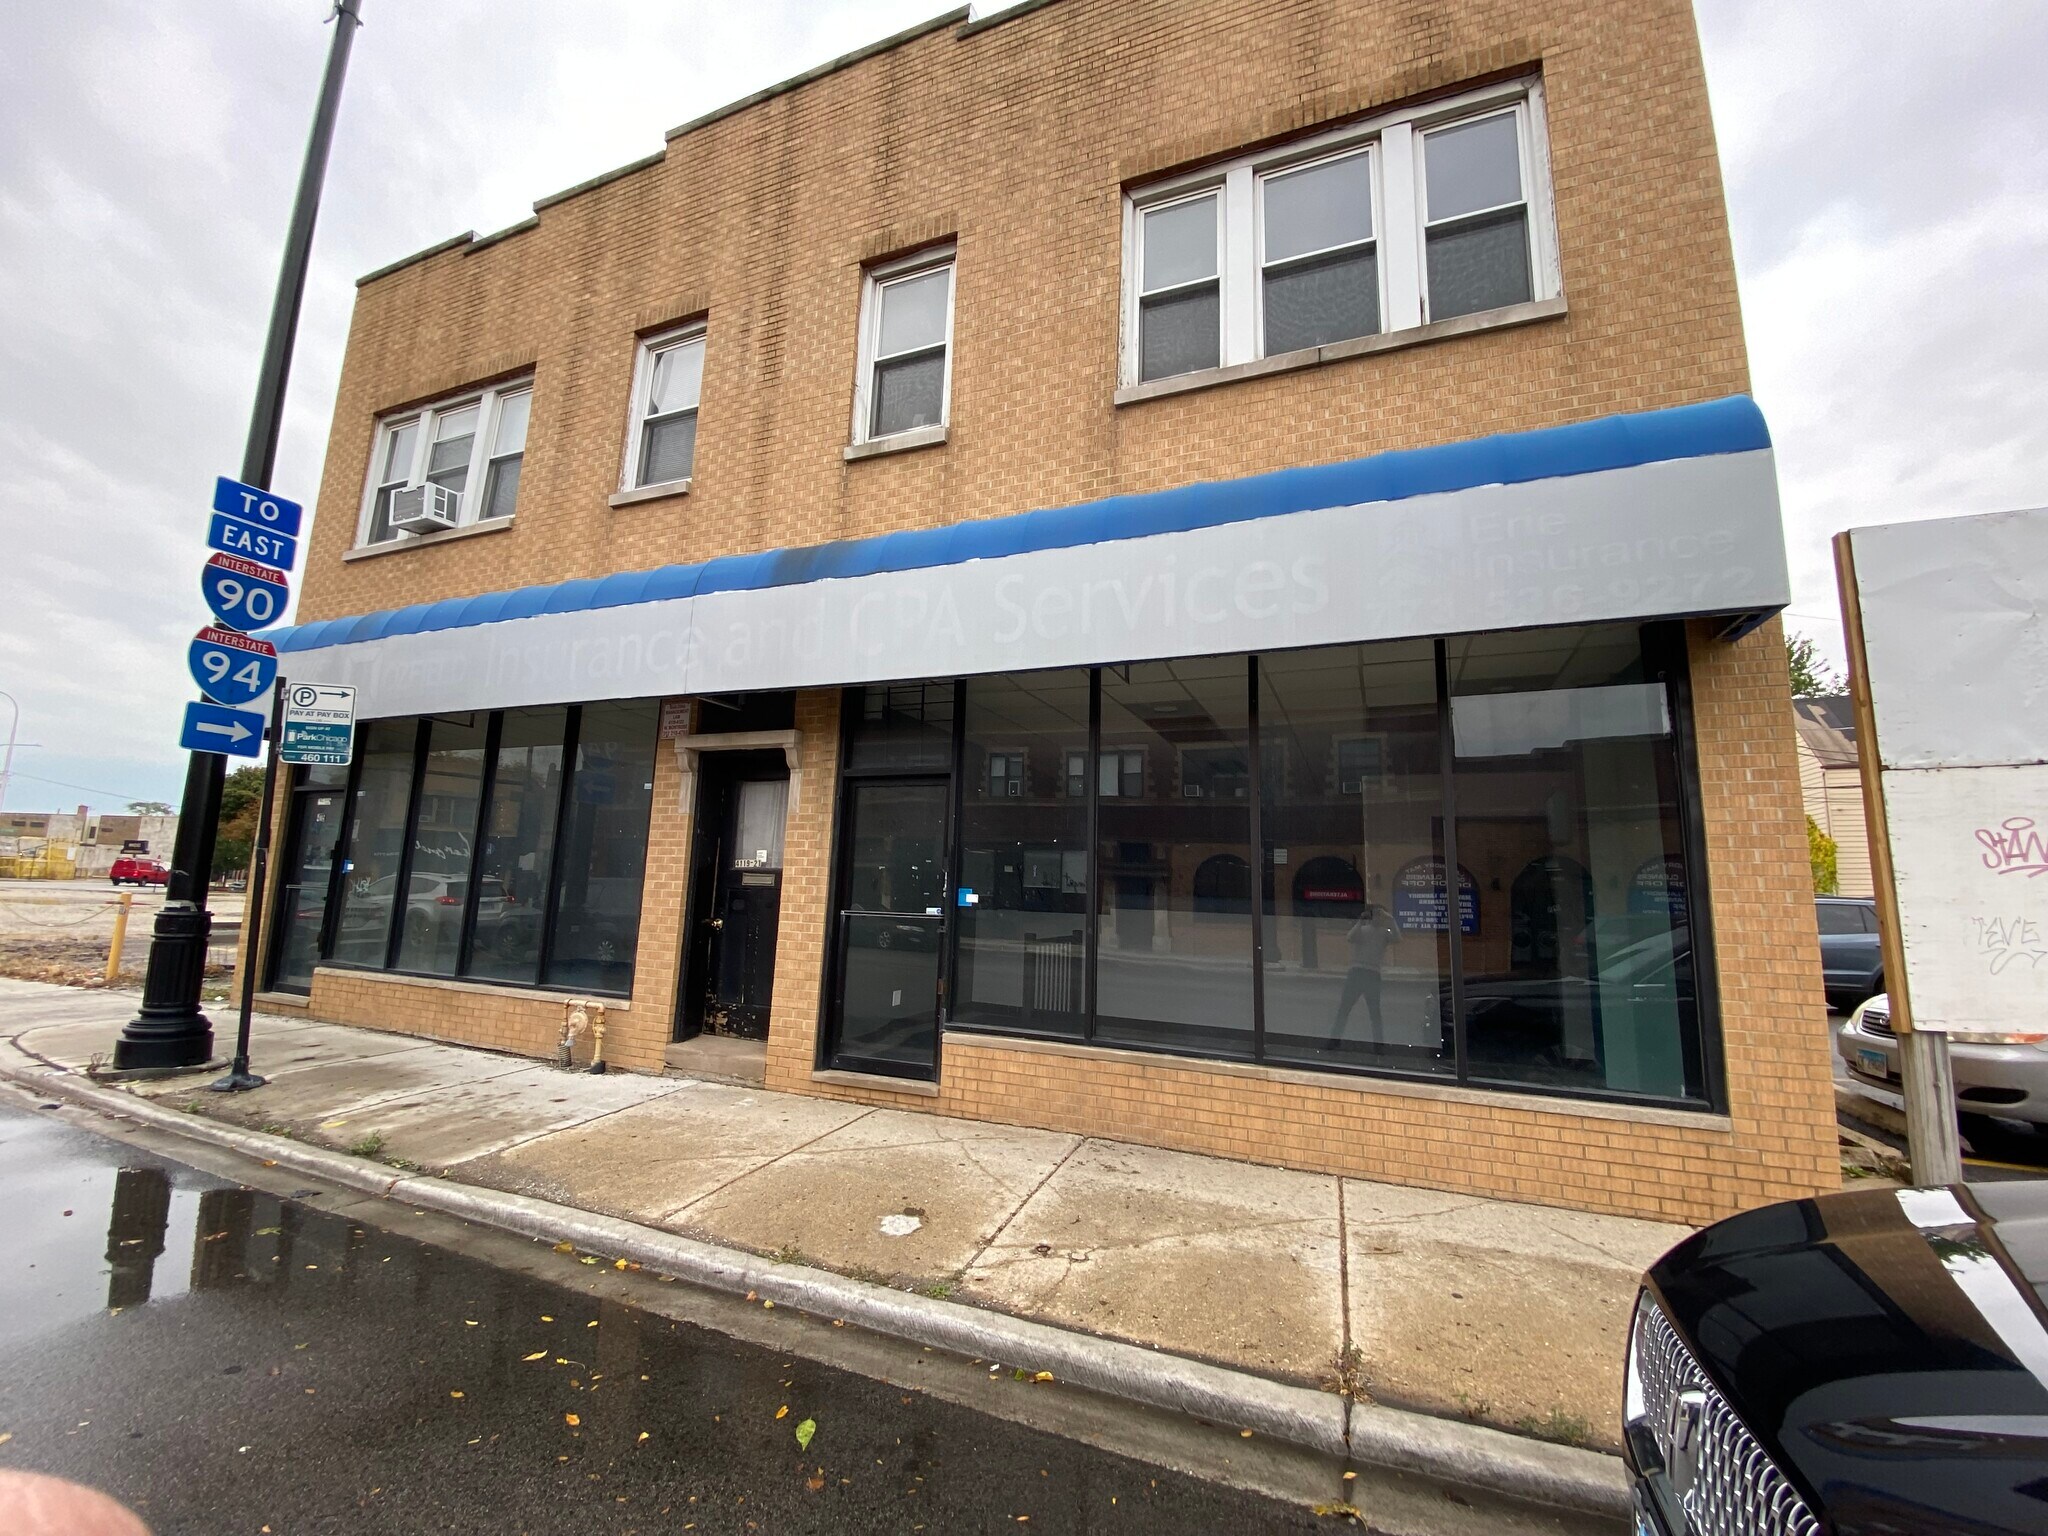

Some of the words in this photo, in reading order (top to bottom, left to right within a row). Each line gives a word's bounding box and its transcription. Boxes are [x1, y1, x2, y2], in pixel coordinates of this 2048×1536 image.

[240, 492, 280, 522] TO
[221, 524, 284, 560] EAST
[218, 556, 280, 583] INTERSTATE
[217, 579, 274, 621] 90
[484, 626, 706, 687] Insurance
[724, 597, 825, 668] and
[849, 582, 967, 656] CPA
[994, 554, 1330, 643] Services
[206, 630, 269, 655] INTERSTATE
[202, 650, 261, 693] 94
[300, 691, 312, 703] P
[297, 732, 348, 743] ParkChicago
[301, 754, 320, 762] 460
[324, 755, 340, 763] 111
[736, 859, 761, 867] 4119-21
